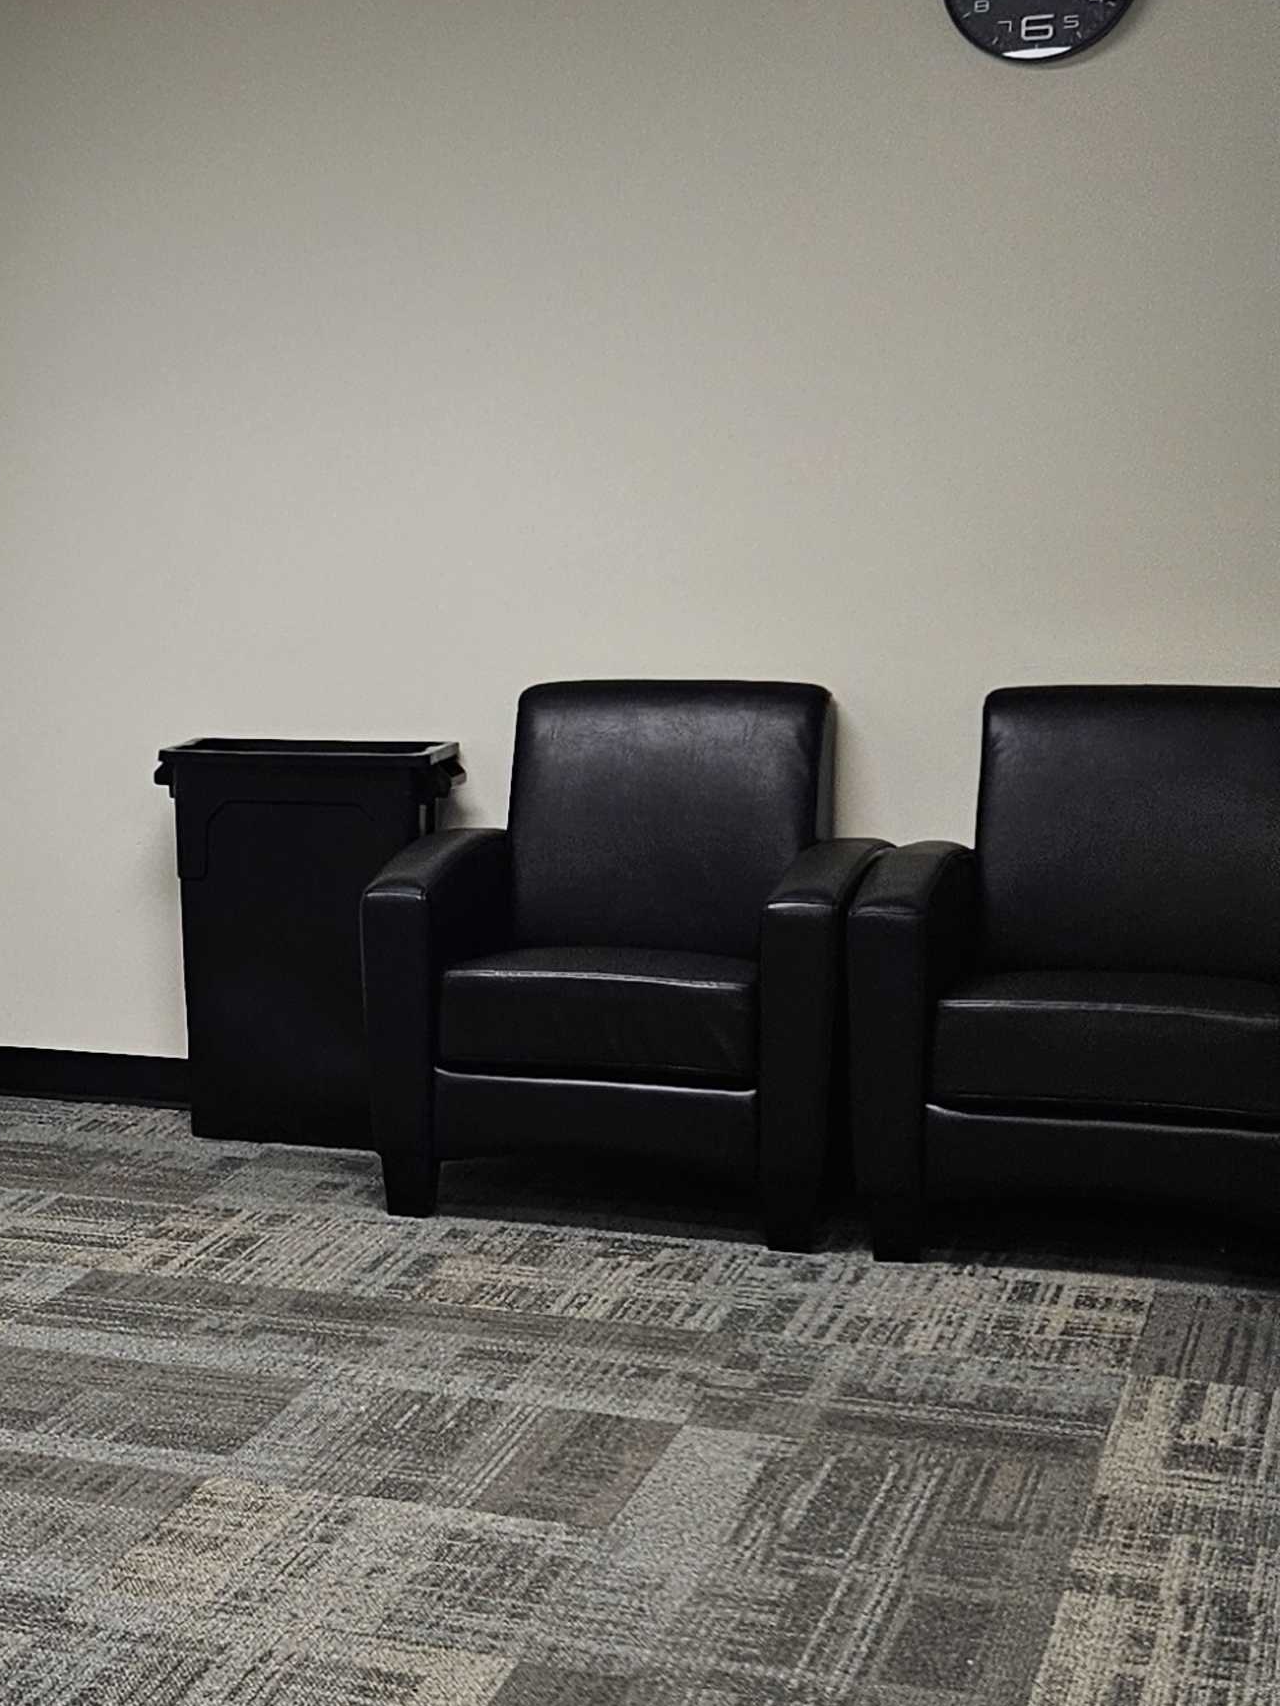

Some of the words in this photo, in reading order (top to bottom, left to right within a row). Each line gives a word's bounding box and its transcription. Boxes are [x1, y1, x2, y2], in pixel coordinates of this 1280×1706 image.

[974, 1, 990, 13] 8
[998, 21, 1012, 33] 7
[1021, 14, 1055, 41] 6
[1063, 14, 1080, 29] 5
